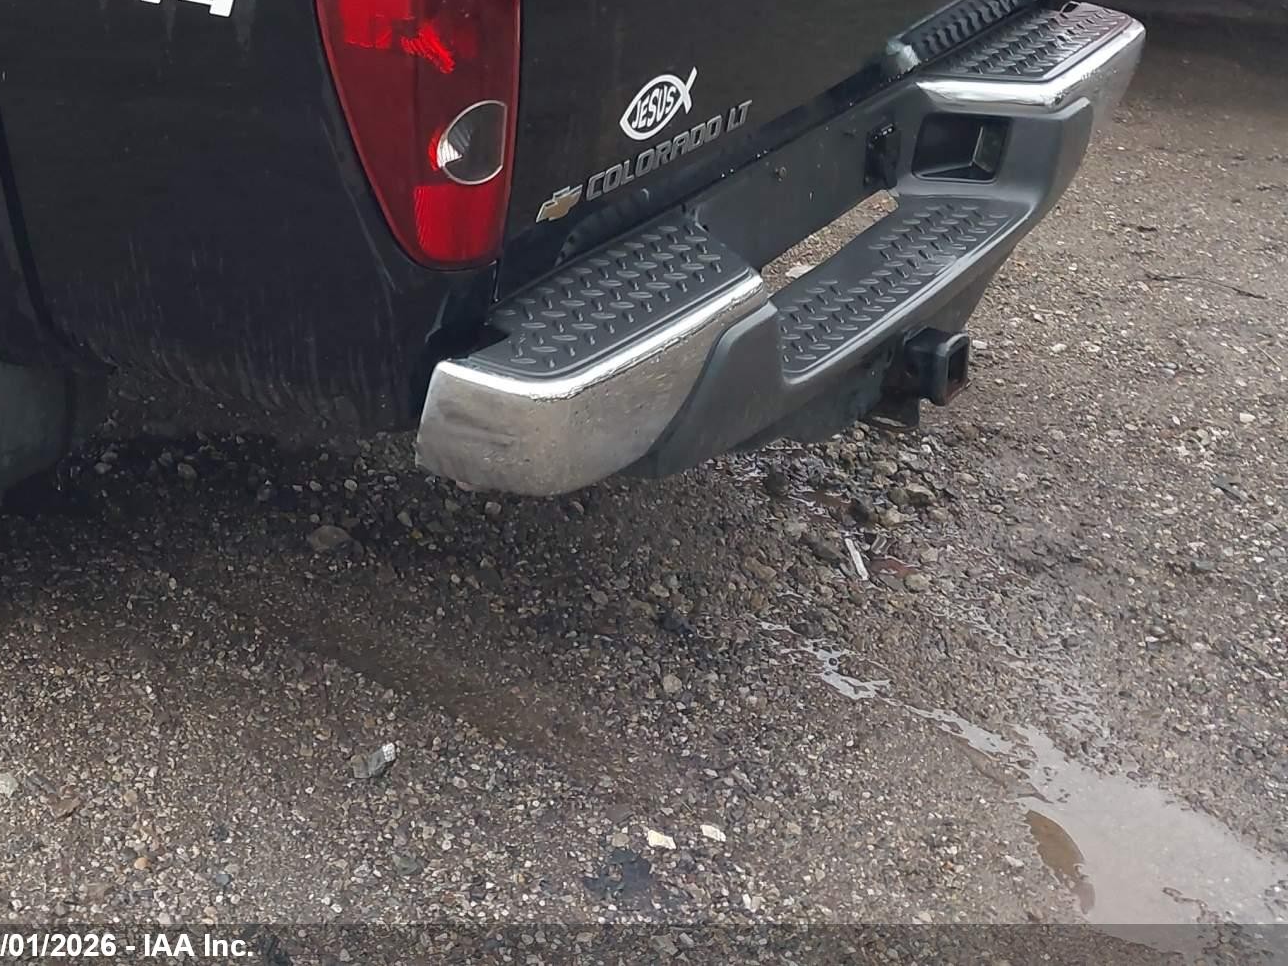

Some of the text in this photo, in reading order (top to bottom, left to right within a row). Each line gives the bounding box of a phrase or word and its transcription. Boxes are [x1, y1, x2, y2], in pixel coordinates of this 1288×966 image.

[631, 85, 677, 130] JESUS
[585, 99, 753, 202] COLORADO LT
